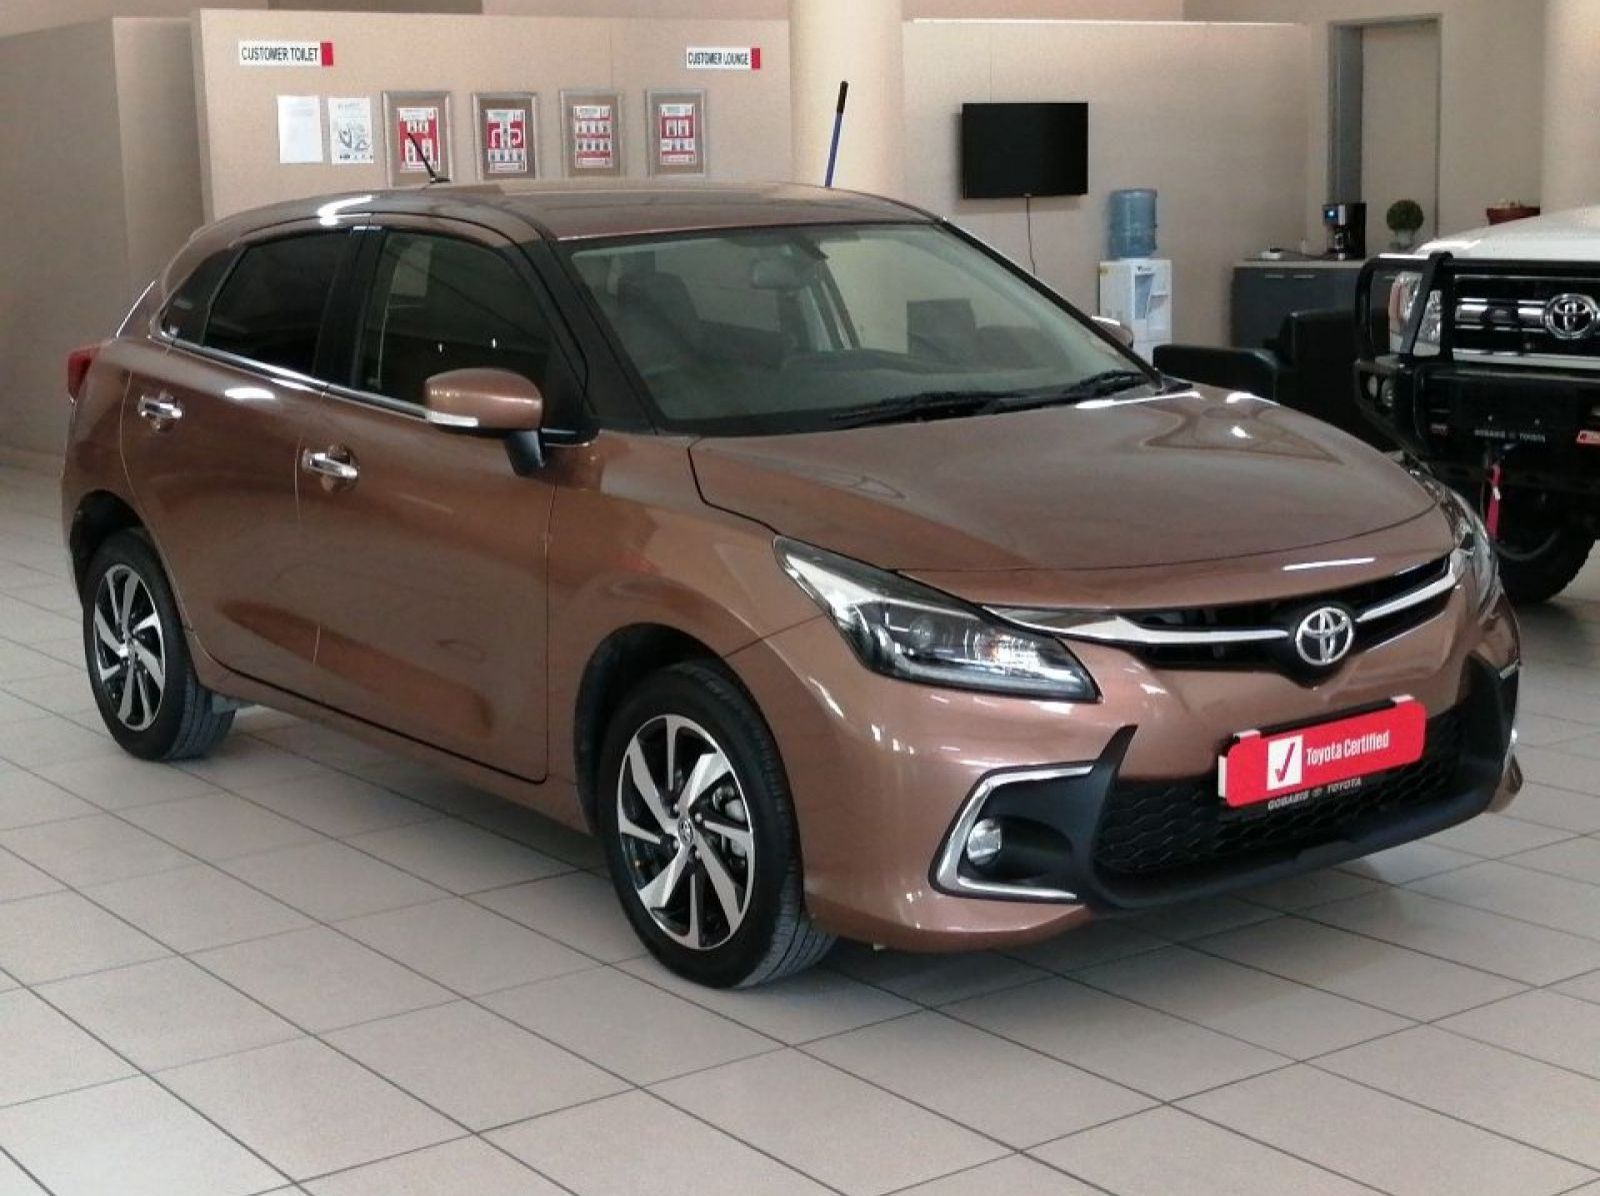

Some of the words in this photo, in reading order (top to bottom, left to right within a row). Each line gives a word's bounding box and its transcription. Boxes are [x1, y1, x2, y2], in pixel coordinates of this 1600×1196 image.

[241, 47, 289, 61] CUSTOMER
[290, 47, 319, 61] TOILET
[688, 52, 722, 65] CUSTOMER
[723, 52, 749, 65] LOUNGE
[1306, 741, 1342, 767] Toyota
[1343, 729, 1390, 757] Certified
[1326, 777, 1362, 794] TOYOTA
